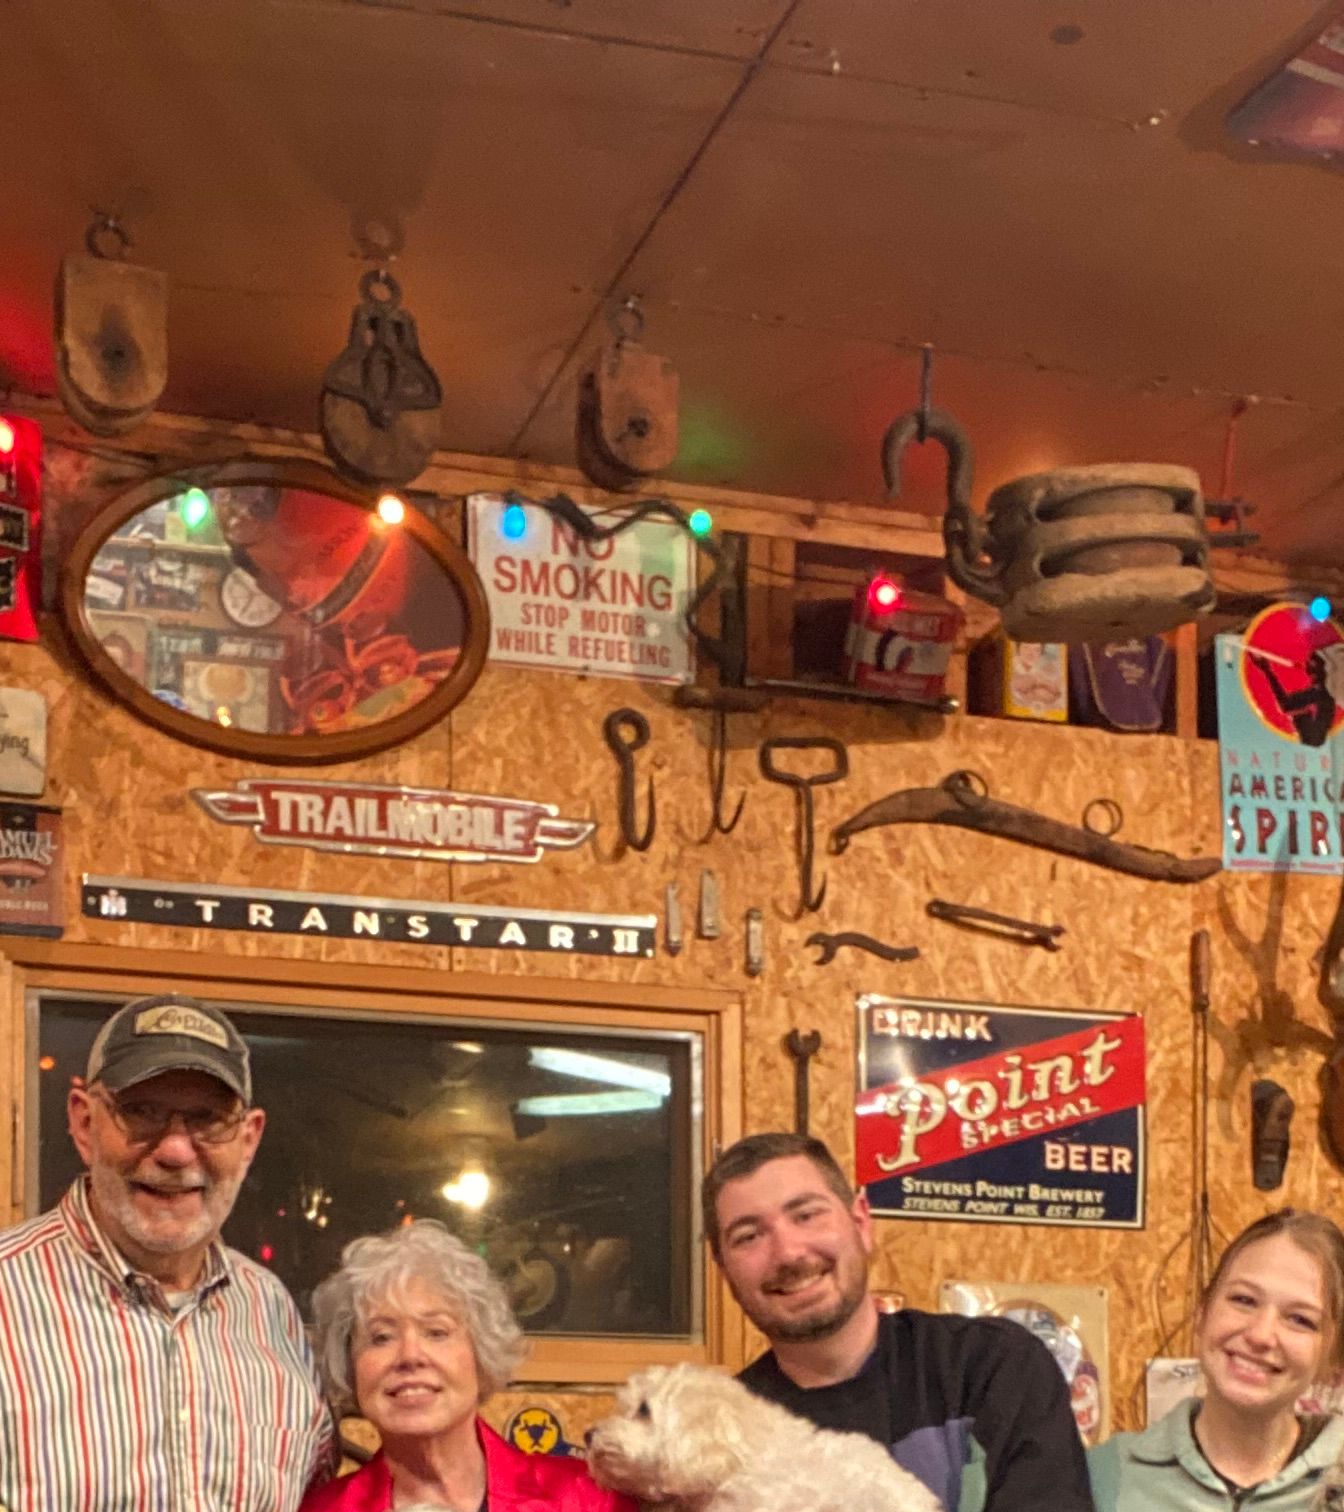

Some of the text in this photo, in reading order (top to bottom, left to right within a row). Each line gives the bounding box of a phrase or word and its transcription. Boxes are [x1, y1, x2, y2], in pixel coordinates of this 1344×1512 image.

[551, 513, 615, 561] NO
[493, 555, 673, 613] SMOKING
[521, 602, 647, 638] STOP MOTOR
[495, 628, 672, 669] WHILE REFUELING
[270, 790, 528, 850] TRAILMOBILE
[195, 898, 576, 950] TRANSTAR
[871, 1008, 992, 1042] DRINK
[875, 1032, 1122, 1172] Point
[960, 1097, 1101, 1150] SPECIAL
[1044, 1141, 1133, 1175] BEER
[901, 1177, 1105, 1204] STEVENS POINT BREWERY
[901, 1197, 961, 1214] STEVENS
[964, 1200, 1009, 1216] POINT
